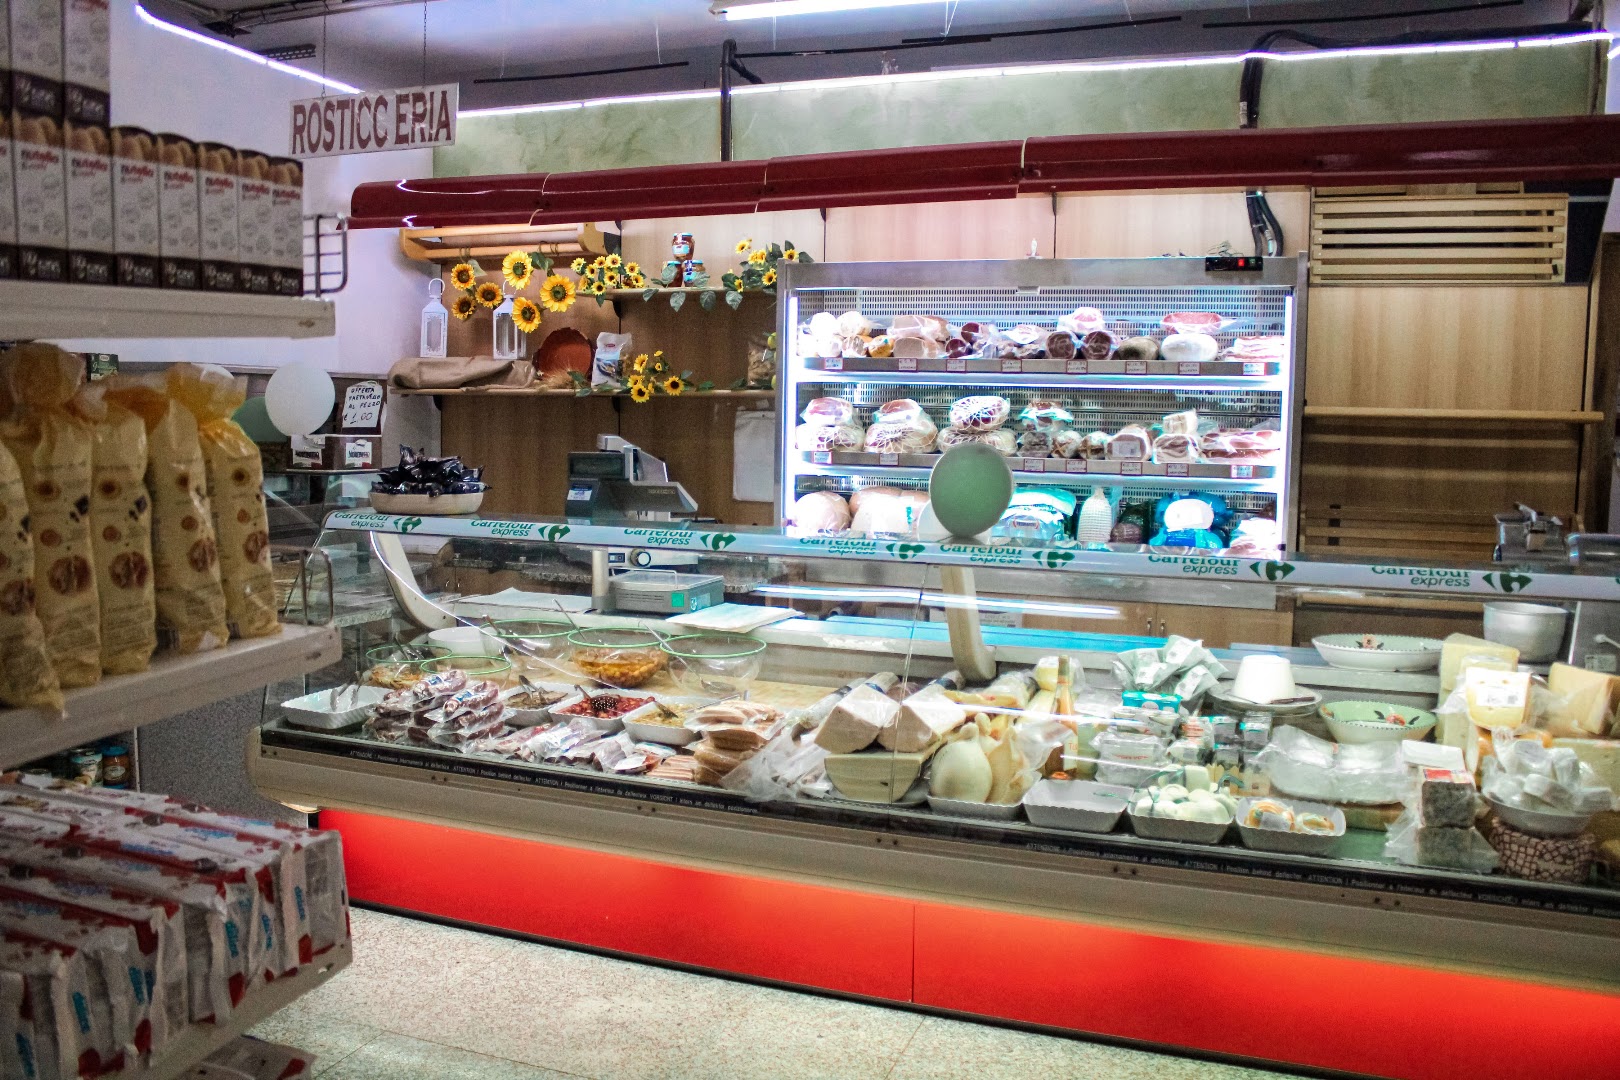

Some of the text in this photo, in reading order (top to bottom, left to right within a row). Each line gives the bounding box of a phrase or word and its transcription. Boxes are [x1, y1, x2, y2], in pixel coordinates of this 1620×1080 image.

[351, 519, 386, 529] express
[491, 527, 530, 538] express
[647, 535, 691, 546] express
[1183, 563, 1238, 576] express
[1410, 576, 1471, 588] express
